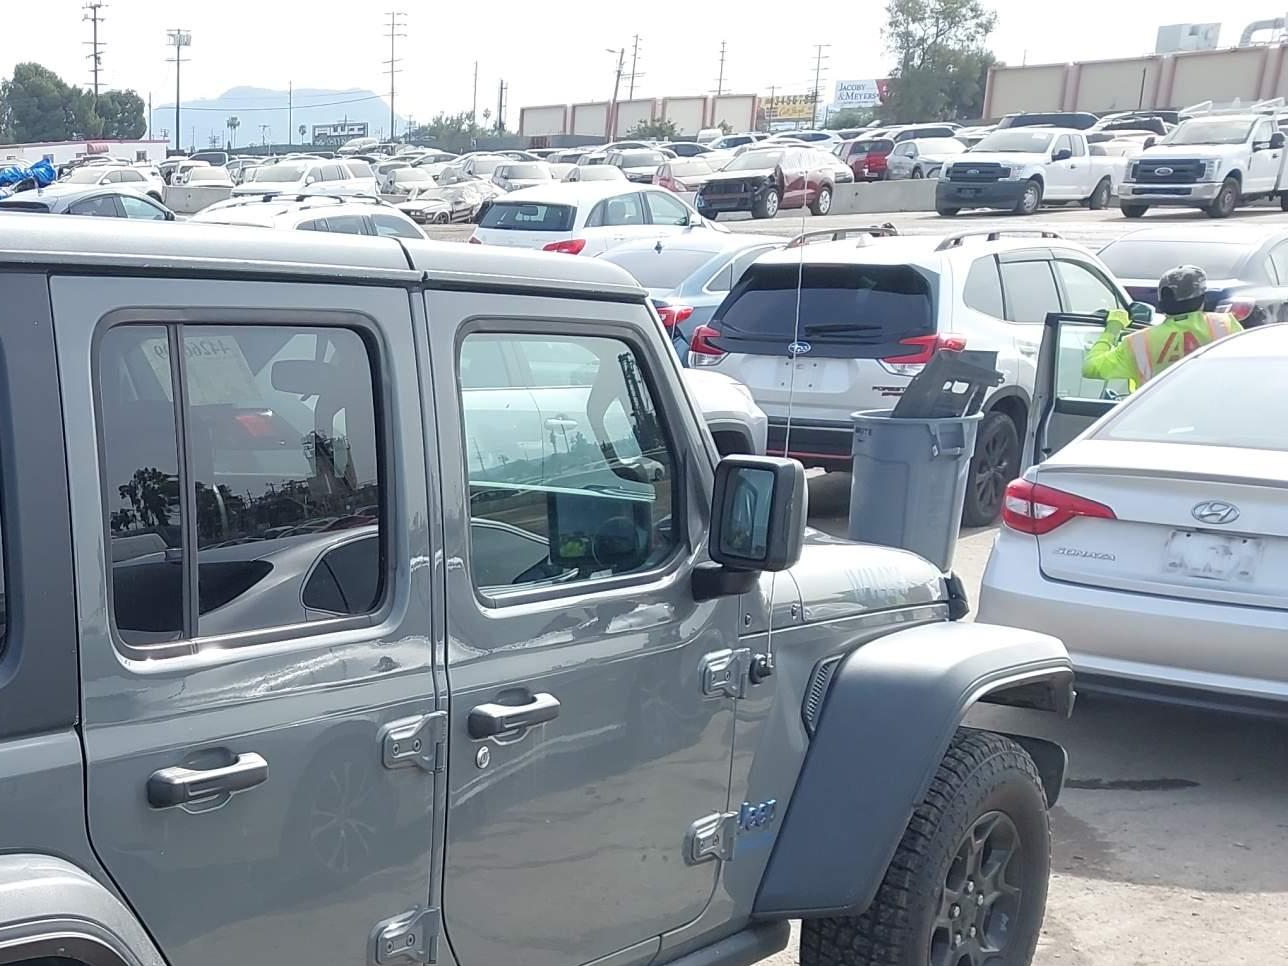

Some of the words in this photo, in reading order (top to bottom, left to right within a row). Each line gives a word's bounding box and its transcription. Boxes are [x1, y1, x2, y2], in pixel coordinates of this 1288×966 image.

[839, 83, 865, 91] JACOBY
[1054, 546, 1116, 561] SONATA
[736, 799, 776, 832] Jeep
